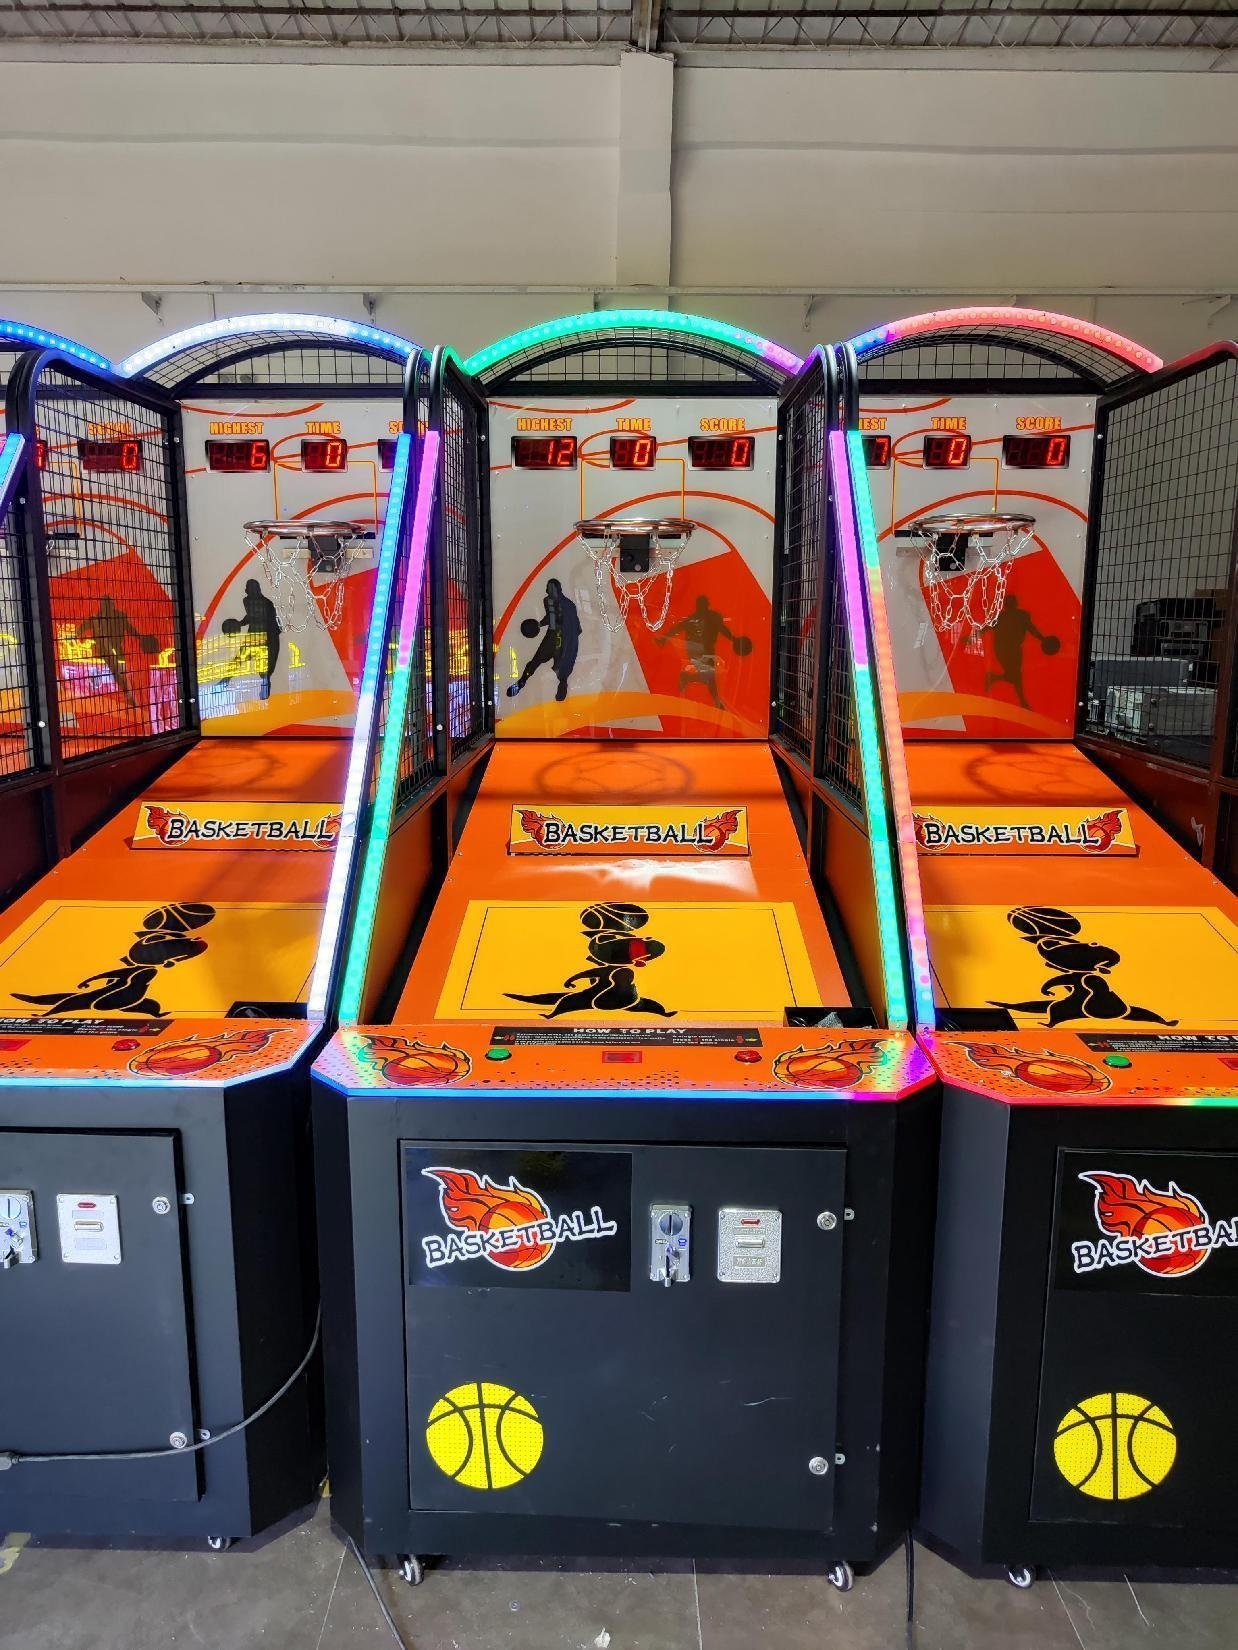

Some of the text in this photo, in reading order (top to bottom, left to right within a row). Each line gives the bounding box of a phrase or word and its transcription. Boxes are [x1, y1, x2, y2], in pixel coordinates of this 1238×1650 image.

[209, 421, 265, 435] HIGHEST
[305, 421, 341, 434] TIME
[516, 417, 573, 432] HIGHEST
[616, 417, 652, 431] TIME
[699, 417, 746, 431] SCORE
[930, 417, 967, 430] TIME
[1016, 417, 1062, 430] SCORE
[250, 441, 267, 467] 6
[325, 441, 342, 467] 0
[546, 438, 575, 465] 12
[632, 438, 652, 466] 0
[730, 438, 750, 466] 0
[947, 438, 967, 465] 0
[1045, 438, 1066, 465] 0
[167, 817, 335, 841] BASKETBALL
[543, 821, 714, 845] BASKETBALL
[923, 823, 1100, 846] BASKETBALL
[423, 1208, 616, 1267] BASKETBALL
